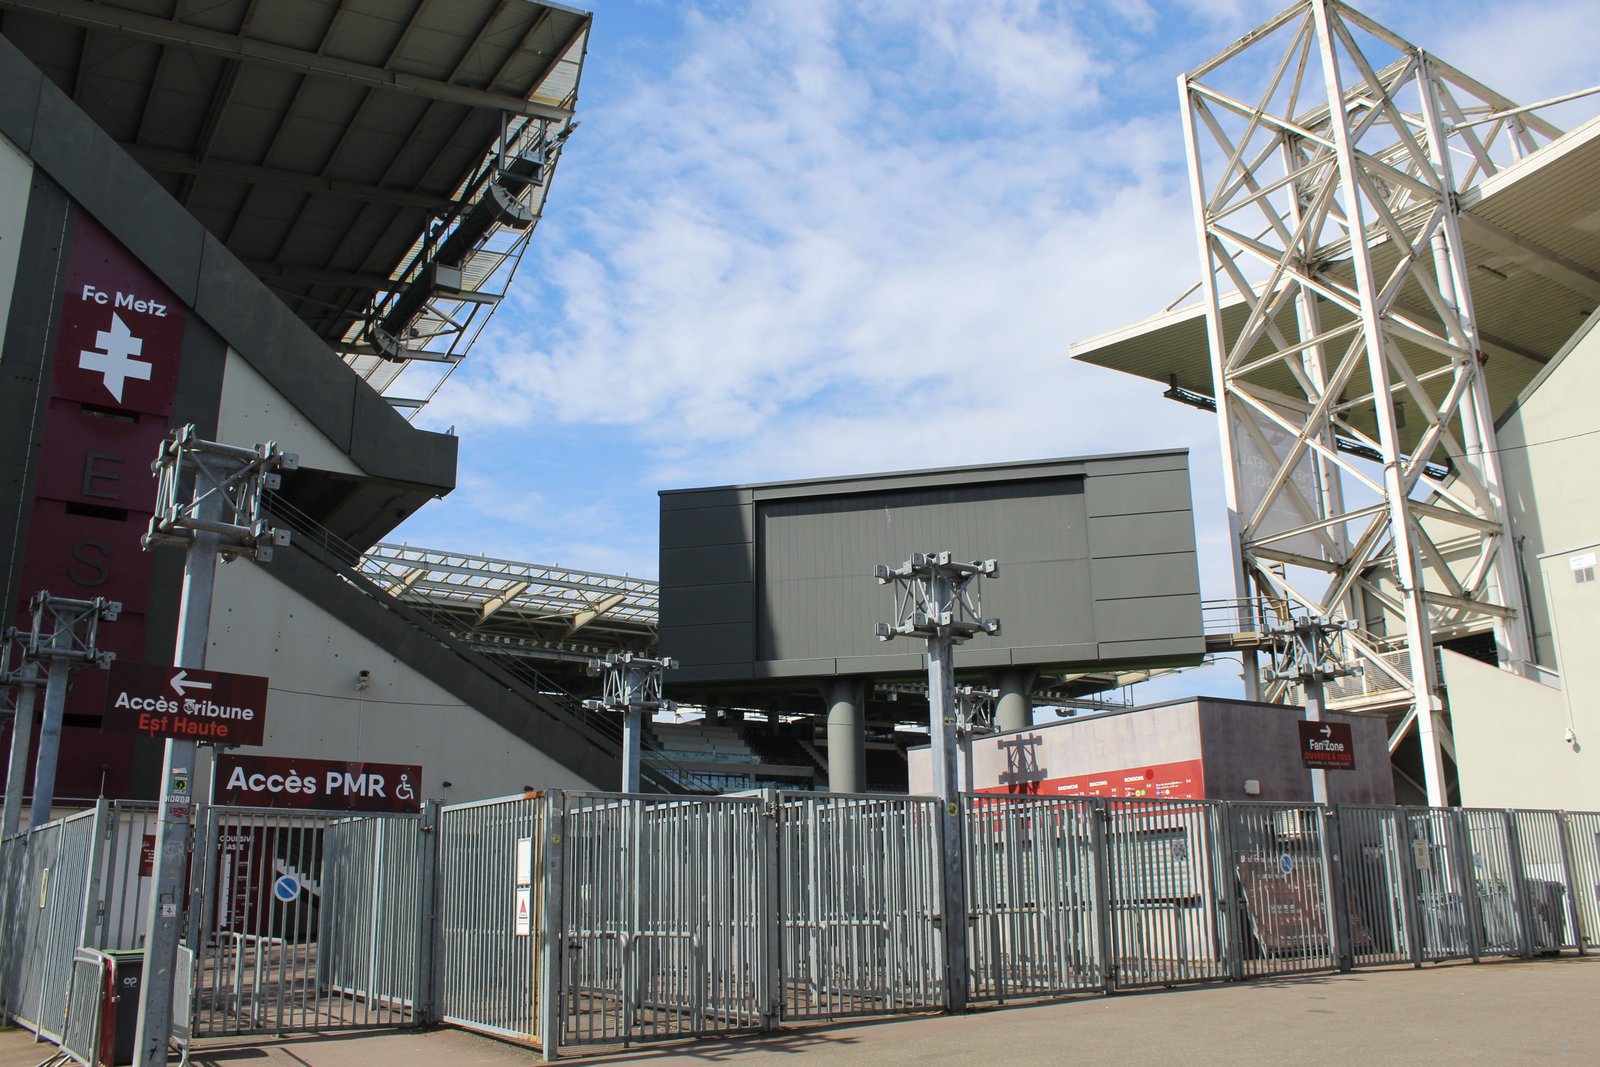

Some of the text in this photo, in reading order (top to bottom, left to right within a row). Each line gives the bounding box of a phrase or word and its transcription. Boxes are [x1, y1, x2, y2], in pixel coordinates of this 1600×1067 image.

[82, 284, 167, 318] Fc Metz
[114, 691, 178, 714] Accès
[138, 713, 229, 737] Est Haute
[1309, 739, 1344, 752] Fan Zone
[226, 766, 387, 798] Accès PMR
